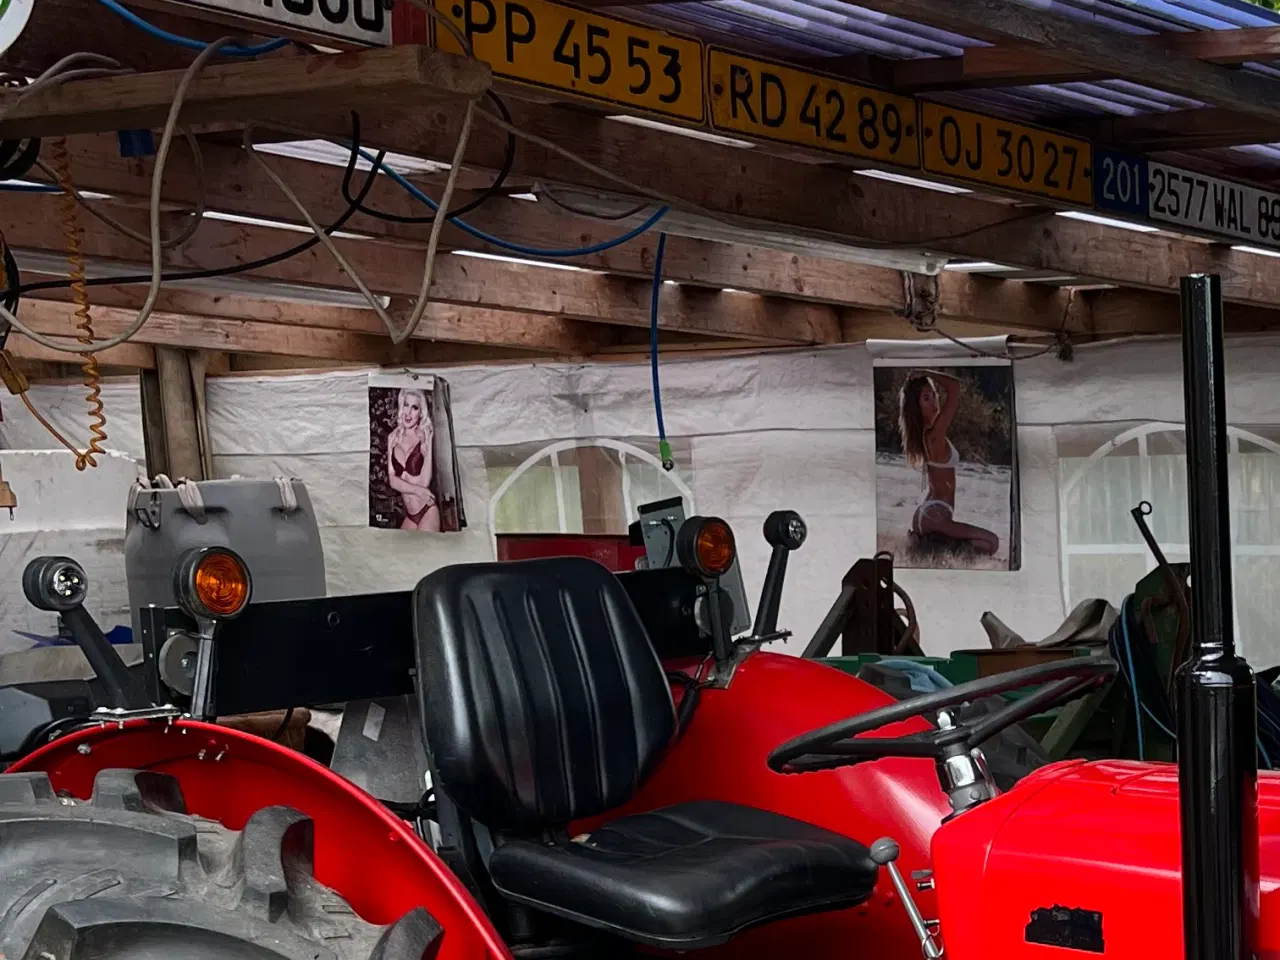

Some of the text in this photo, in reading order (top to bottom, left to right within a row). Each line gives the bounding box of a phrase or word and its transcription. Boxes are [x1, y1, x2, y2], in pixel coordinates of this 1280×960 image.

[463, 0, 537, 63] PP
[553, 20, 612, 85] 45
[627, 36, 682, 103] 53
[730, 64, 901, 155] RD 42 89
[940, 116, 1077, 191] OJ 30 27
[1103, 157, 1139, 205] 201
[1153, 168, 1208, 222] 2577
